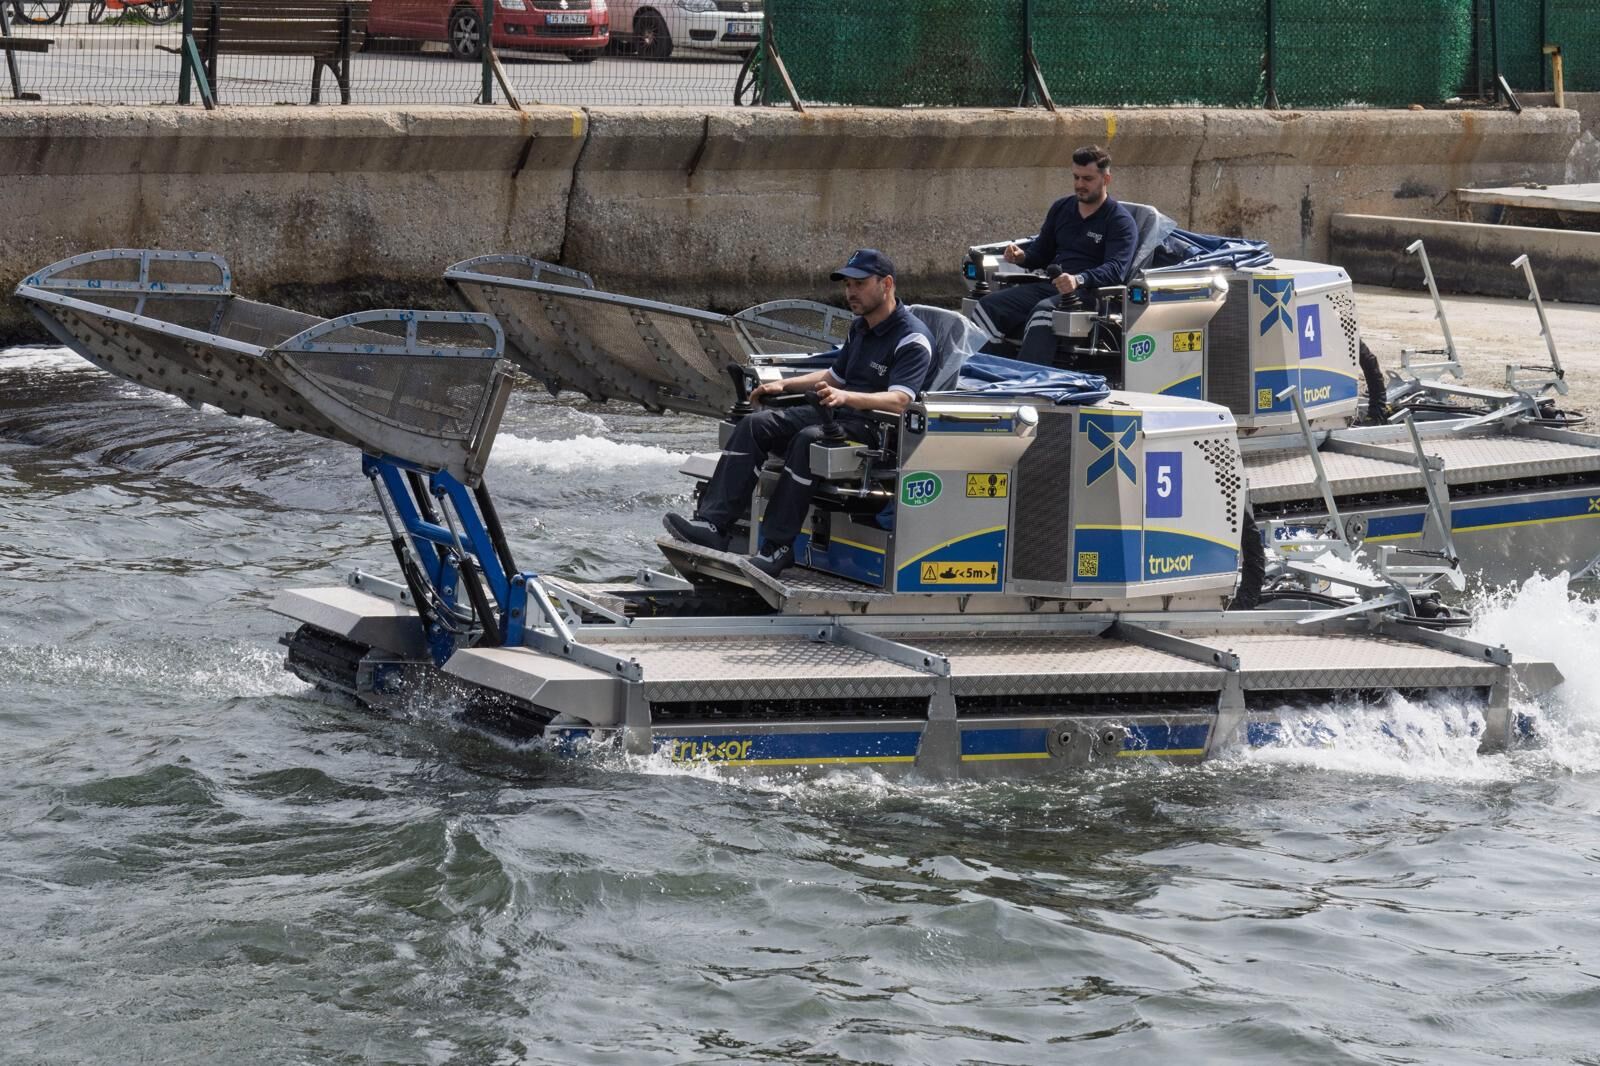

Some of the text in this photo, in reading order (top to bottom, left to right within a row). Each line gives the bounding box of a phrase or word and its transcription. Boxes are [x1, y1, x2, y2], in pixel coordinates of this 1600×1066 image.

[1304, 315, 1315, 342] 4
[1131, 339, 1151, 358] T30
[1304, 385, 1331, 404] truxor
[906, 478, 936, 500] T30
[1156, 465, 1172, 498] 5
[1148, 553, 1194, 575] truxor
[671, 737, 753, 763] truxor
